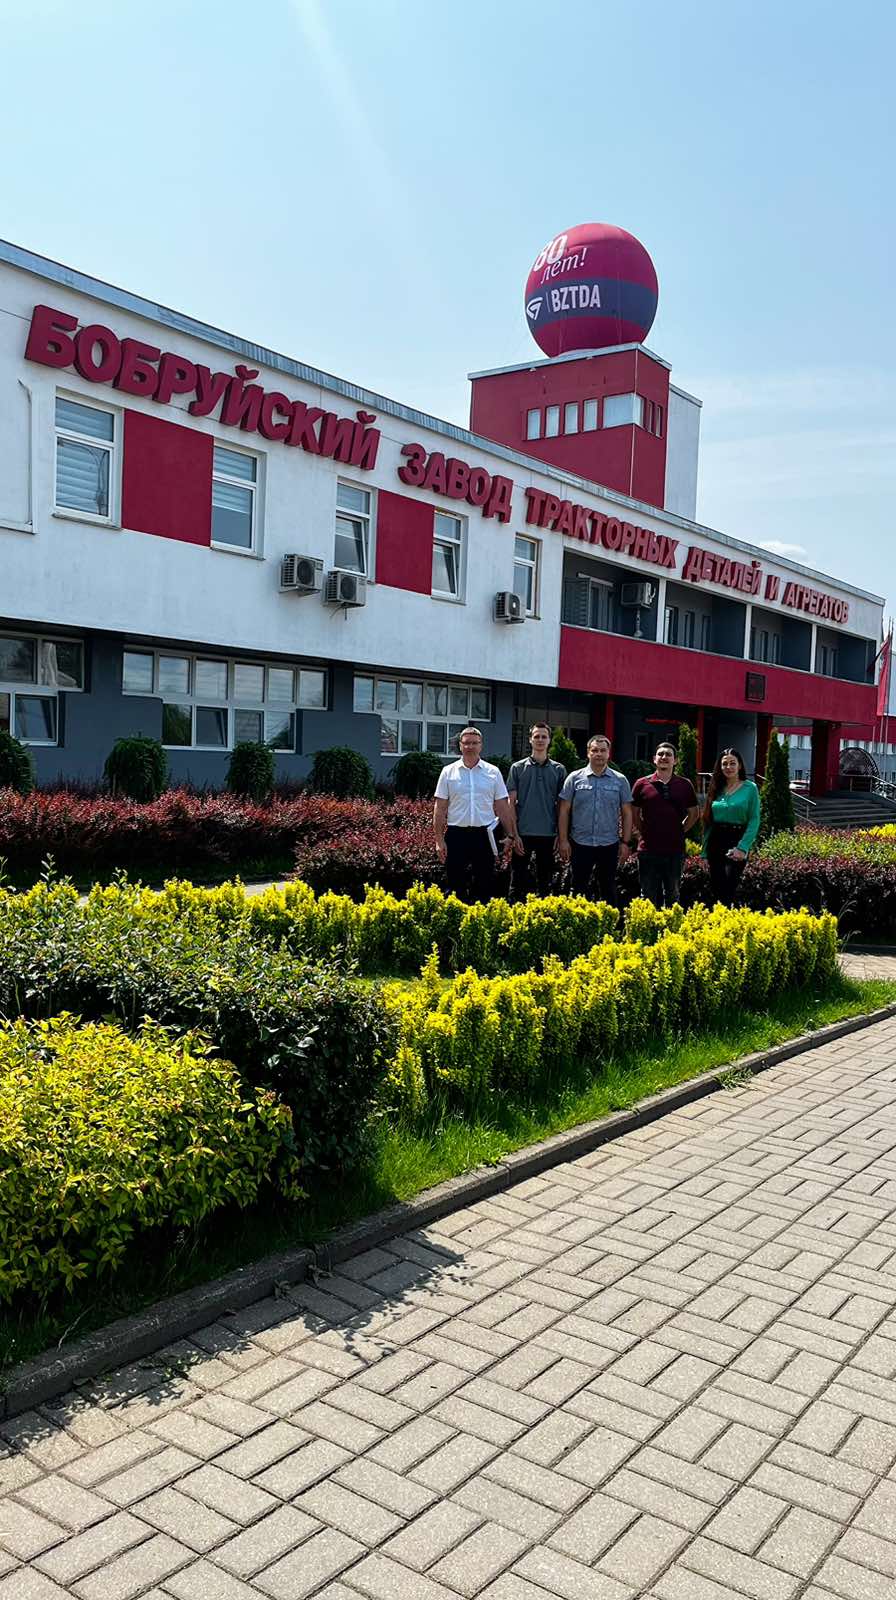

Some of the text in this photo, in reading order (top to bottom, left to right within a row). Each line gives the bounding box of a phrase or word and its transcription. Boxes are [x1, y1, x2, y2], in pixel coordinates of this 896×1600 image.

[541, 248, 587, 284] лет!
[551, 285, 601, 312] BZTDA
[24, 304, 849, 624] БОБРУЙСКИЙ ЗАВОД ТРАКТОРНЫХ ДЕТАЛЕЙ И АГРЕГАТОВ
